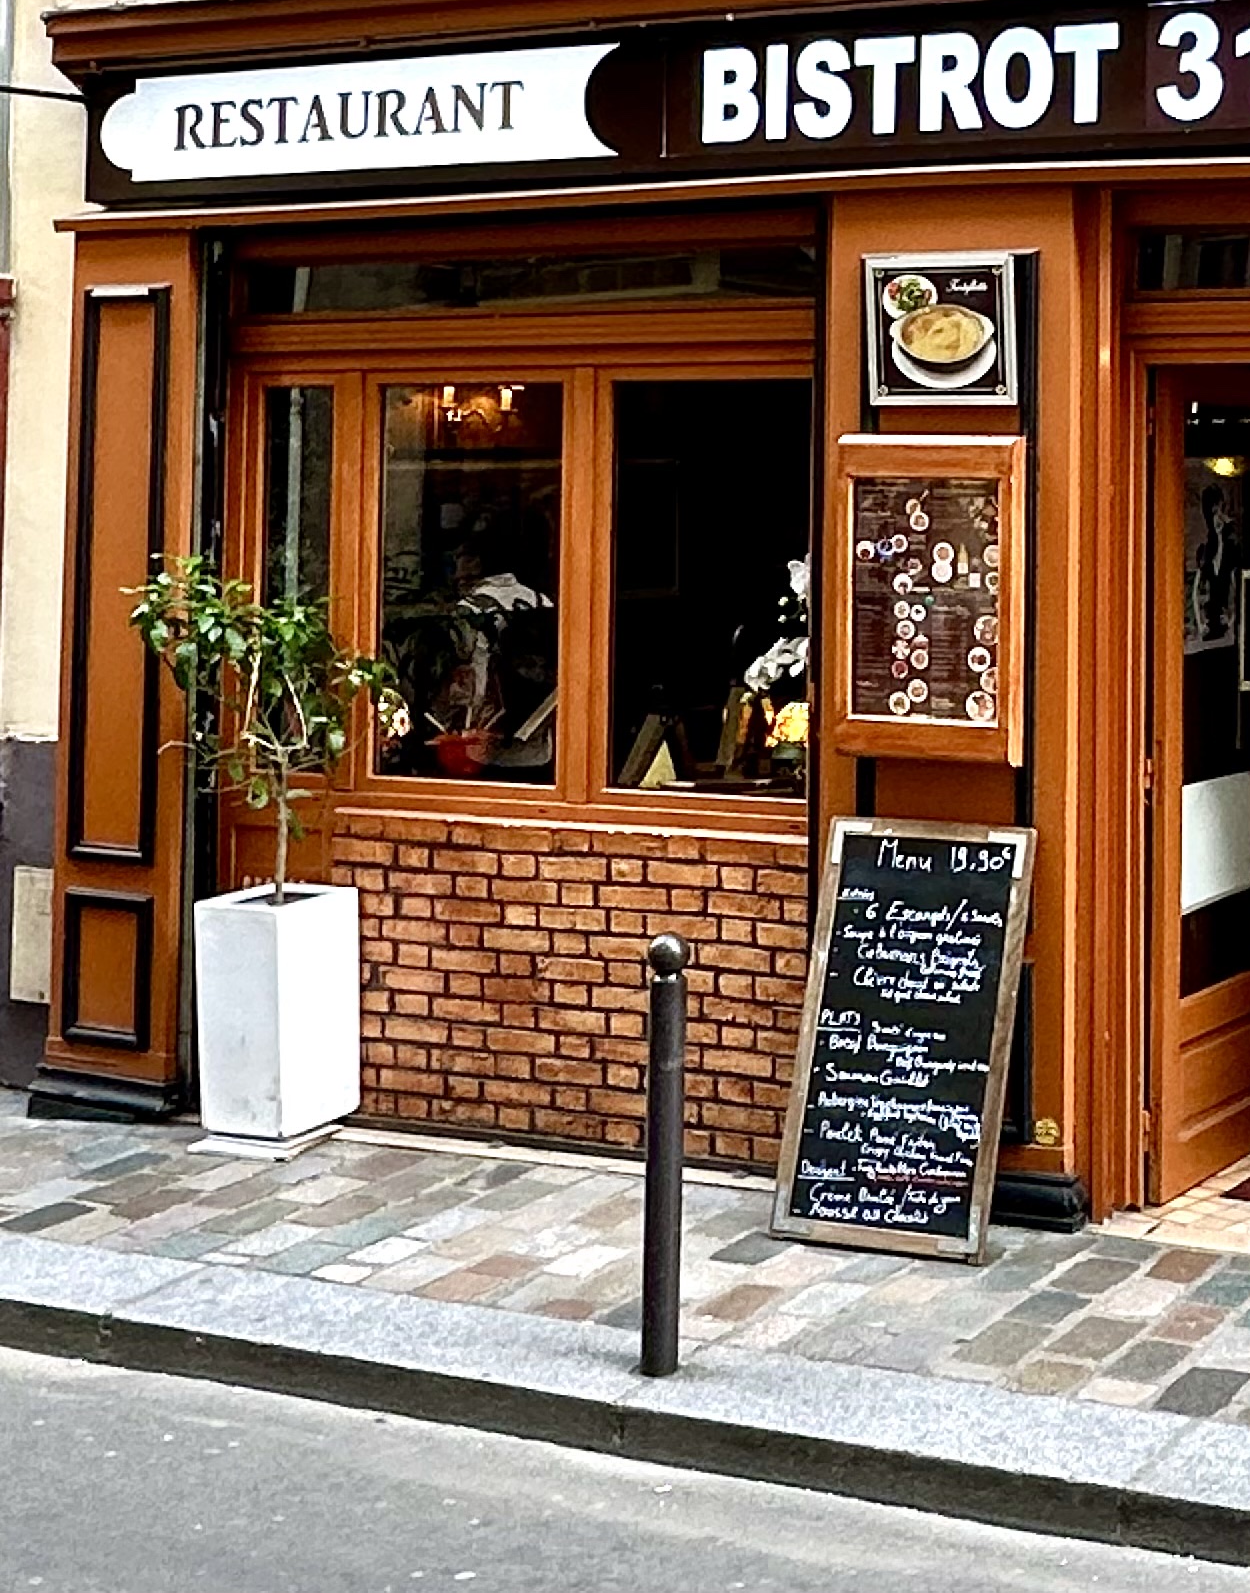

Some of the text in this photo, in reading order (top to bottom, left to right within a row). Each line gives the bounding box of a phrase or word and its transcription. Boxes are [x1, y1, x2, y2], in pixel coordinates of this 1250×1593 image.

[173, 79, 524, 152] RESTAURANT
[700, 21, 1120, 145] BISTROT
[877, 838, 932, 872] Menu
